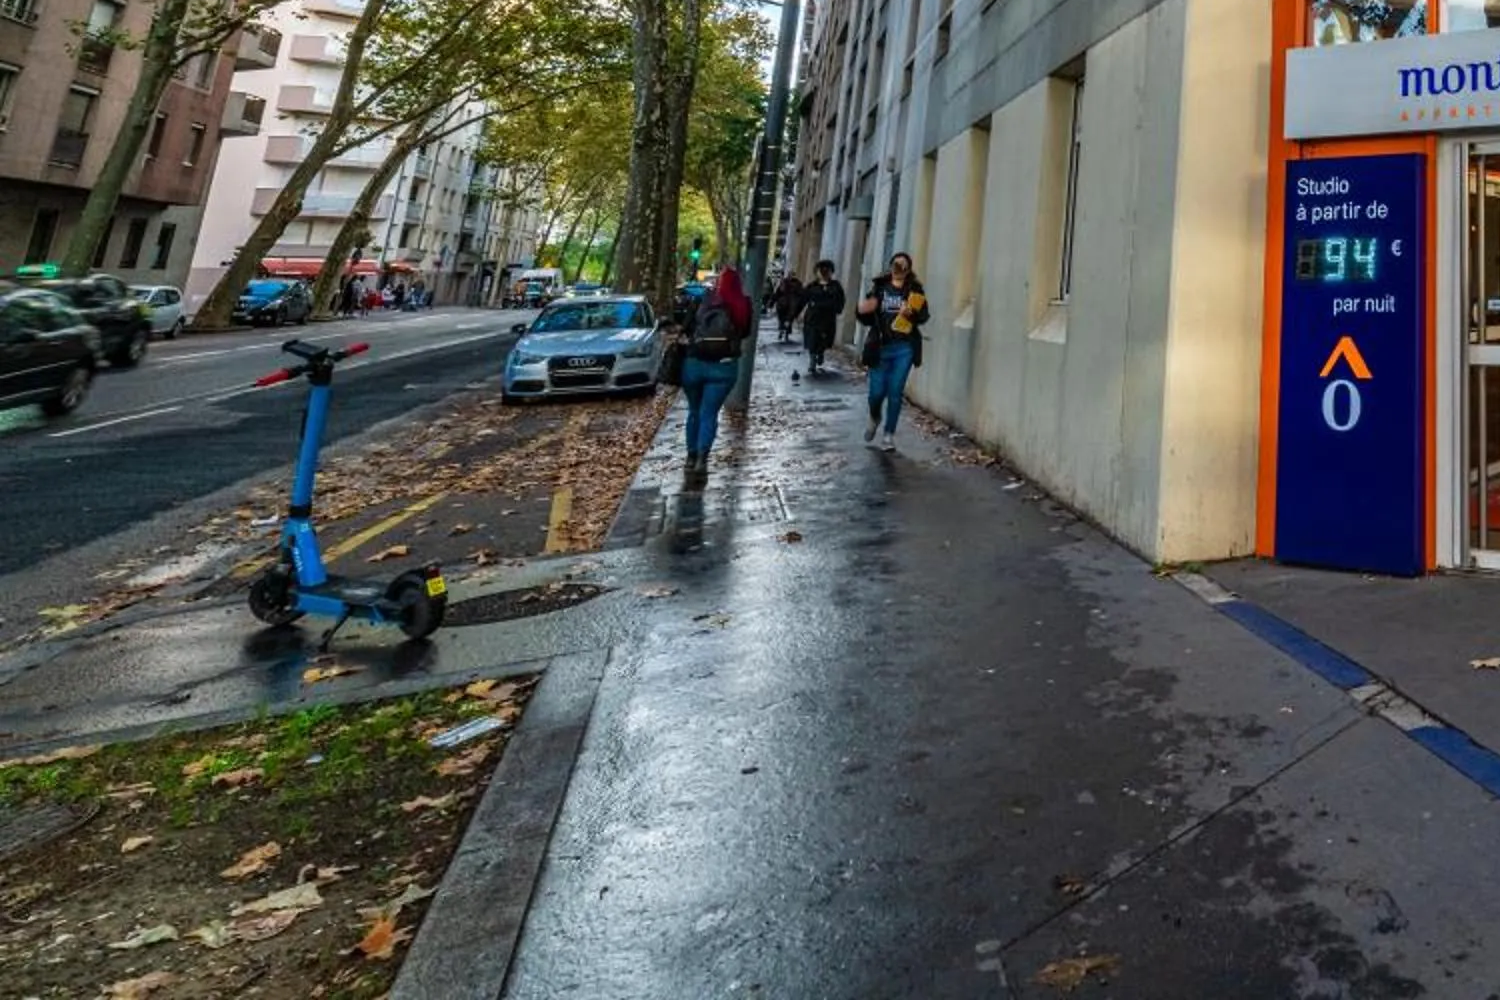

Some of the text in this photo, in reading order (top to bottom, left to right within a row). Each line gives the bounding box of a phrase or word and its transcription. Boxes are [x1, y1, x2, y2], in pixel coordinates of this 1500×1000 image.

[1297, 176, 1350, 196] Studio
[1295, 200, 1389, 225] à partir de
[1324, 236, 1403, 282] 94 €
[1333, 294, 1396, 317] par nuit
